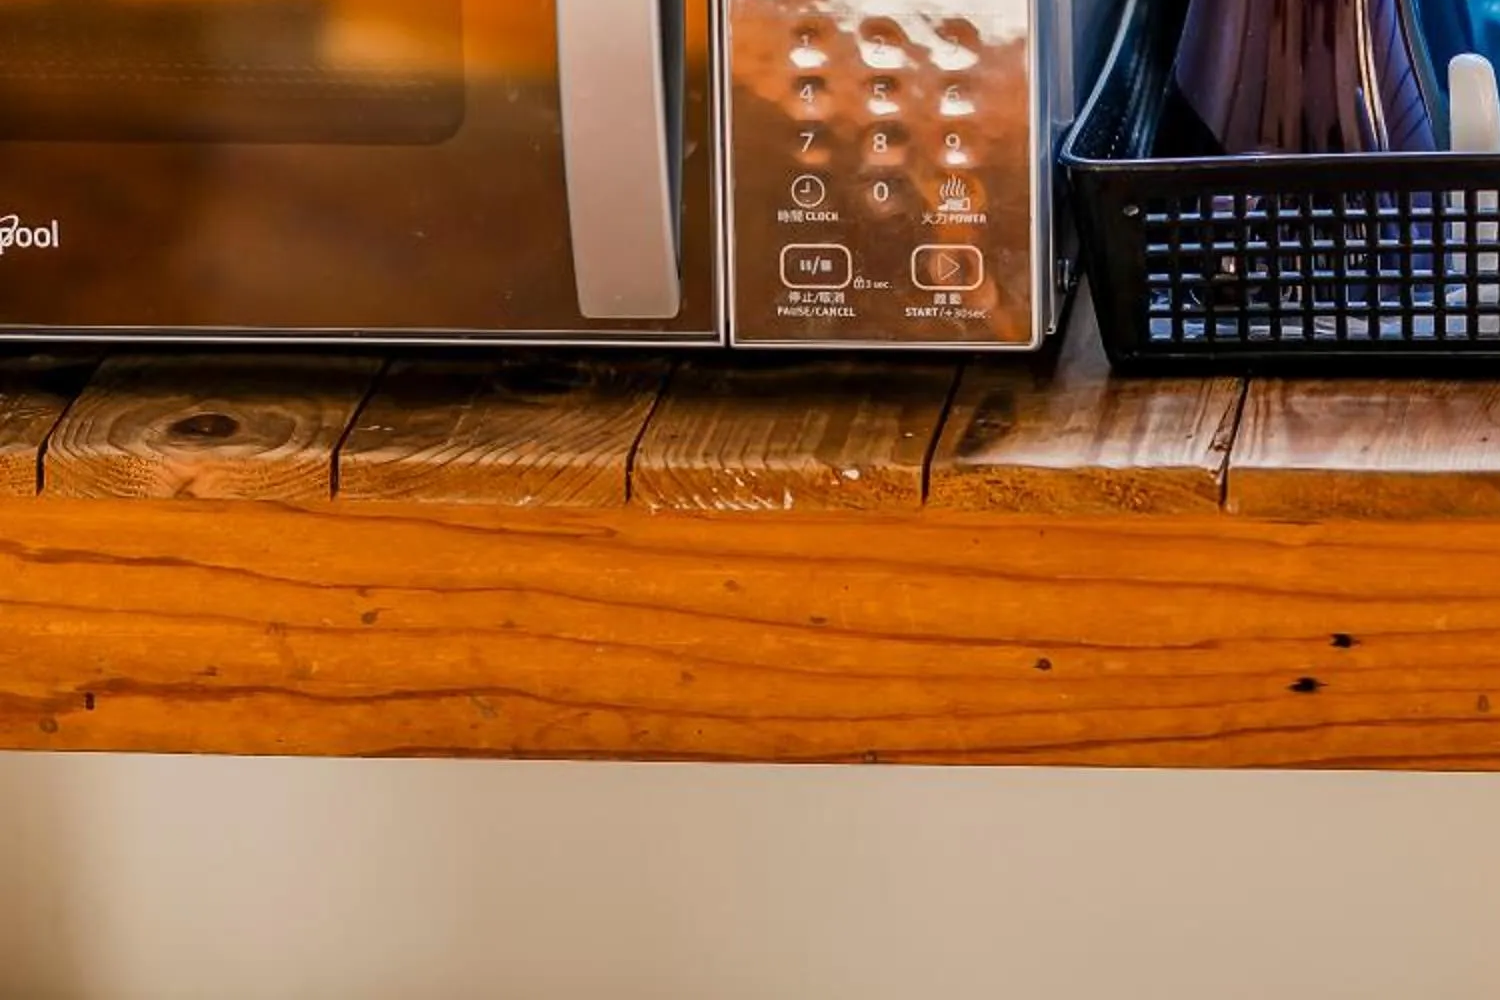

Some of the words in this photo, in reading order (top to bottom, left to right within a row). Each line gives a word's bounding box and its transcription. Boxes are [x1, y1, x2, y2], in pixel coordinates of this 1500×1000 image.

[872, 35, 886, 55] 2
[799, 85, 814, 102] 4
[873, 85, 887, 102] 5
[946, 86, 960, 103] 6
[800, 134, 814, 152] 7
[872, 133, 888, 152] 8
[945, 133, 960, 152] 9
[872, 183, 888, 202] 0
[805, 211, 839, 221] CLOCK
[949, 213, 987, 224] POWER
[777, 306, 857, 317] PAUSE/CANCEL
